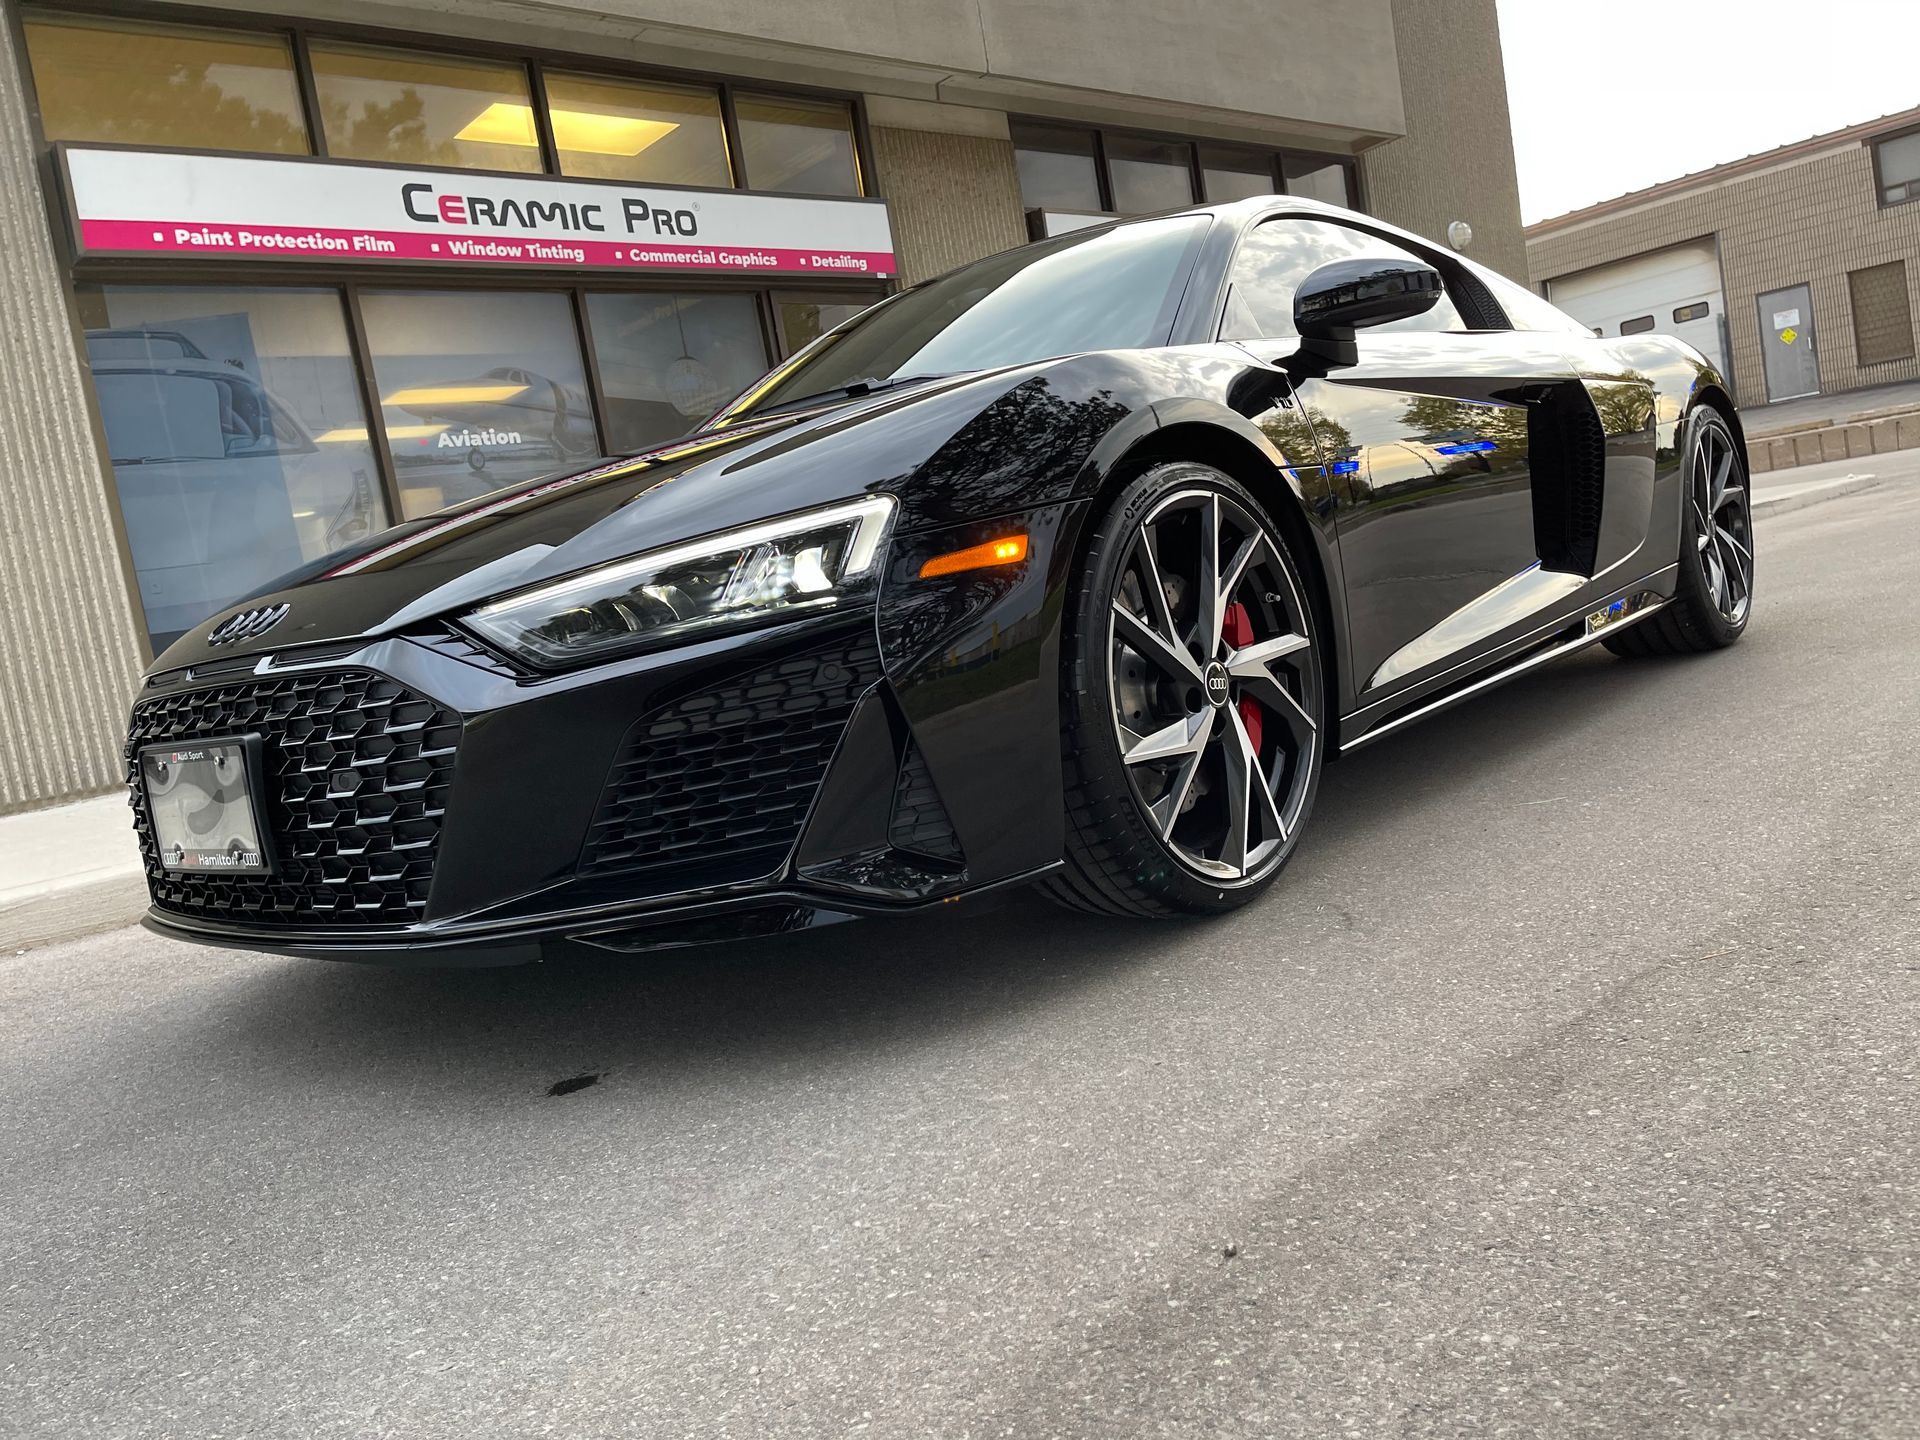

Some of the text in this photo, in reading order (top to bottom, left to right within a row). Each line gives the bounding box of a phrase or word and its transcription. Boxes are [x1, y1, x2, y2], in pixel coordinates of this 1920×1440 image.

[401, 183, 604, 232] CERAMIC
[174, 228, 396, 252] Paint Protection Film
[448, 240, 585, 262] Window Tinting
[629, 249, 777, 268] Commercial Graphics
[812, 255, 868, 271] Detailing
[437, 428, 522, 448] Aviation
[188, 751, 204, 761] Sport
[198, 853, 238, 866] Hamilton
